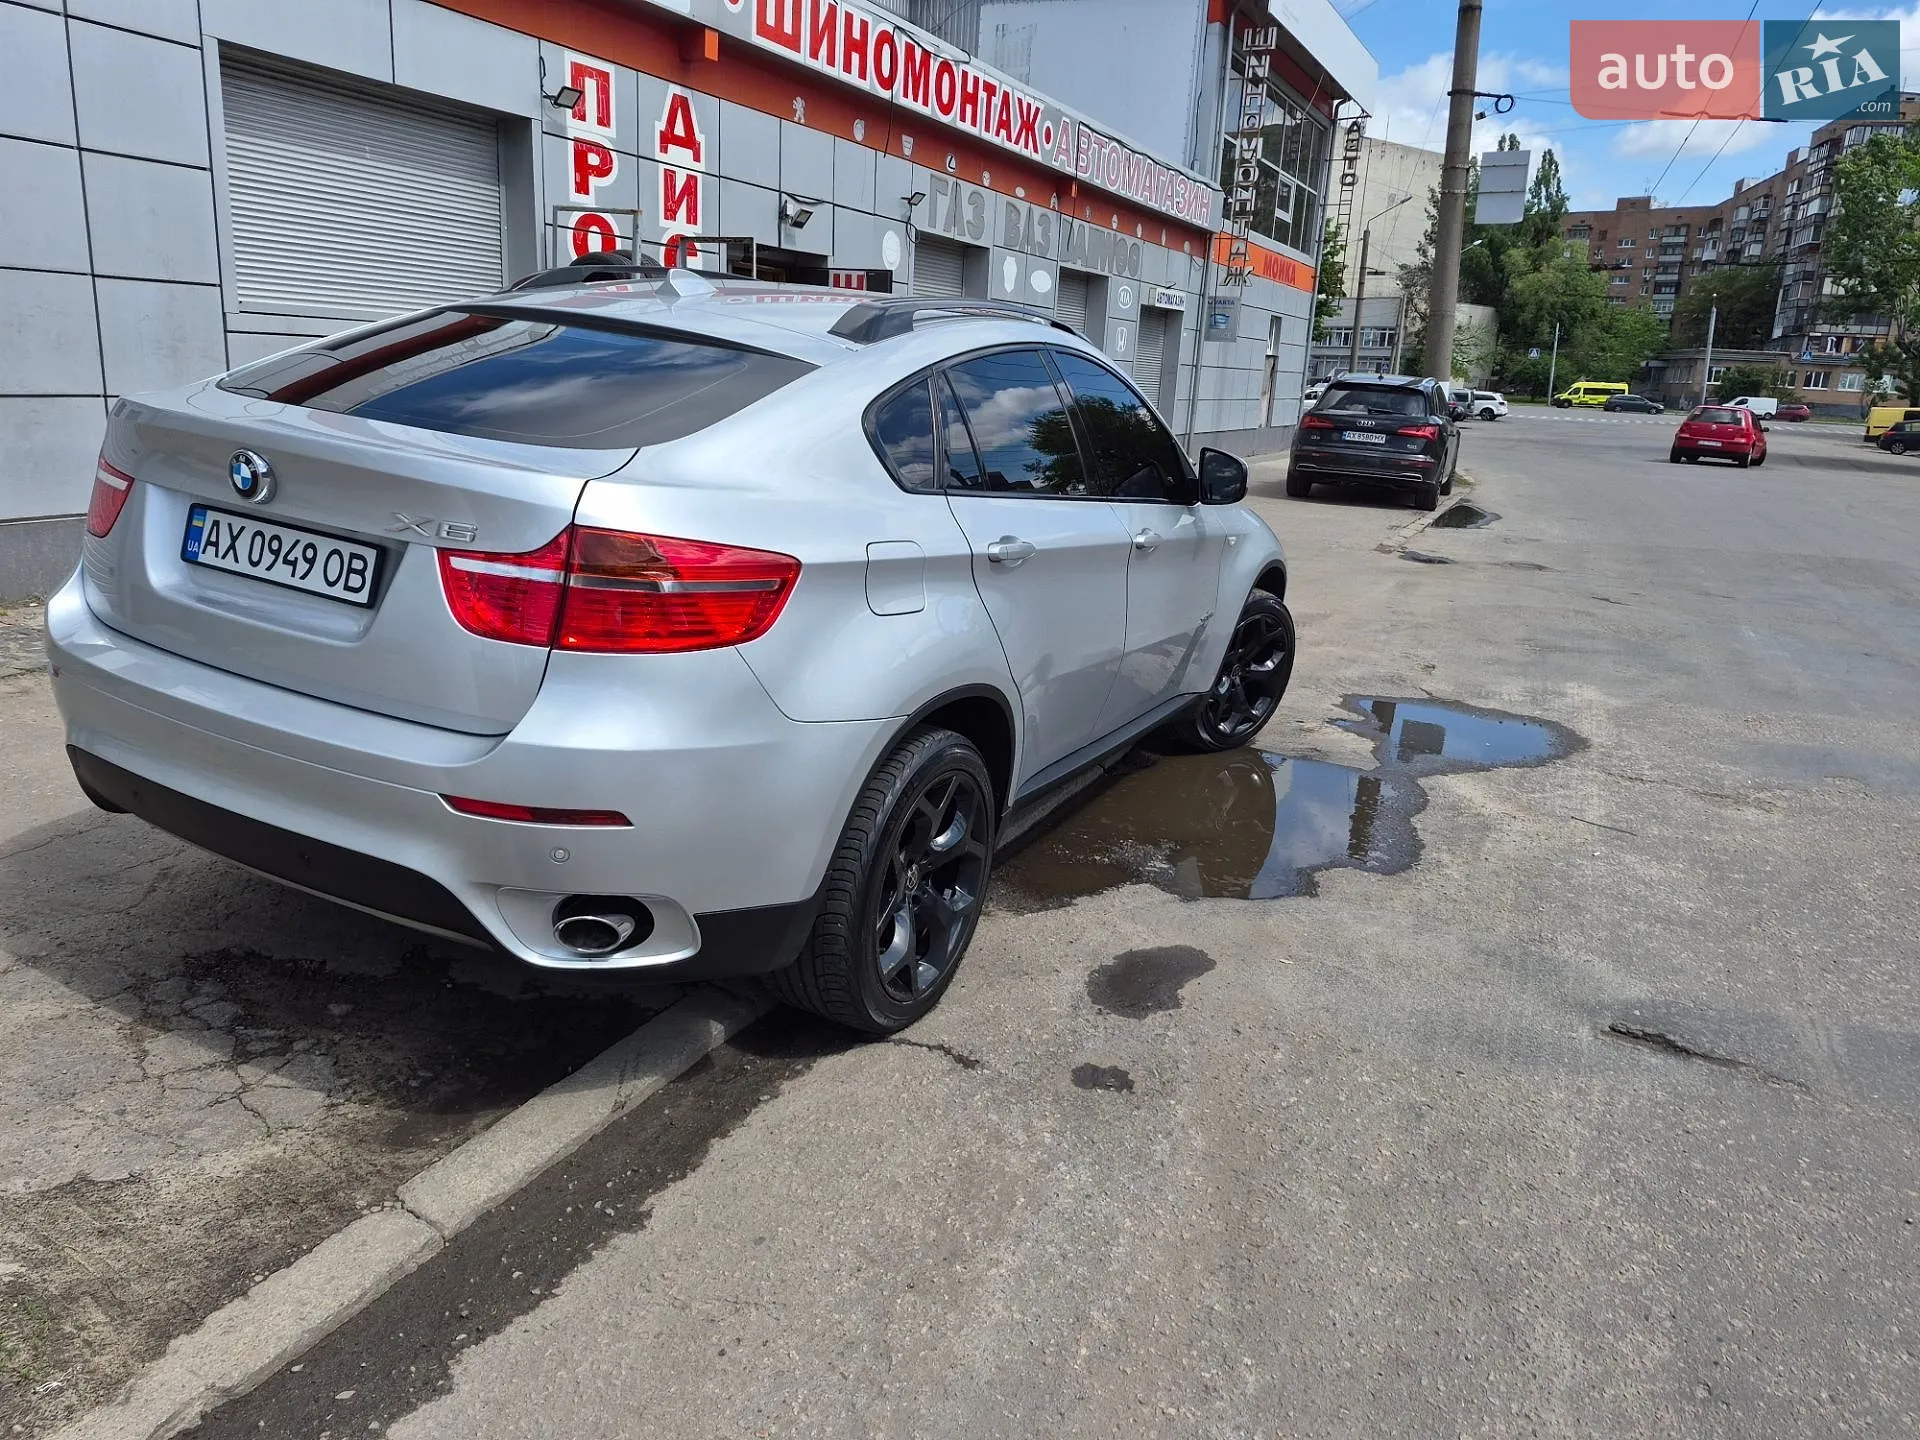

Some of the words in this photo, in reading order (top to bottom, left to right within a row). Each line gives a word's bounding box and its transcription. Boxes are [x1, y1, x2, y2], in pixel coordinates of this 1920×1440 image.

[756, 0, 1042, 155] ШИНОМОНТАЖ
[1053, 117, 1211, 228] АВТОМАГАЗИН
[927, 174, 986, 241] ГАЗ
[1003, 200, 1052, 257] ВАЗ
[187, 540, 199, 553] UA
[202, 519, 252, 564] AX
[248, 530, 318, 581] 0949
[323, 551, 369, 594] OB
[385, 511, 480, 542] X6
